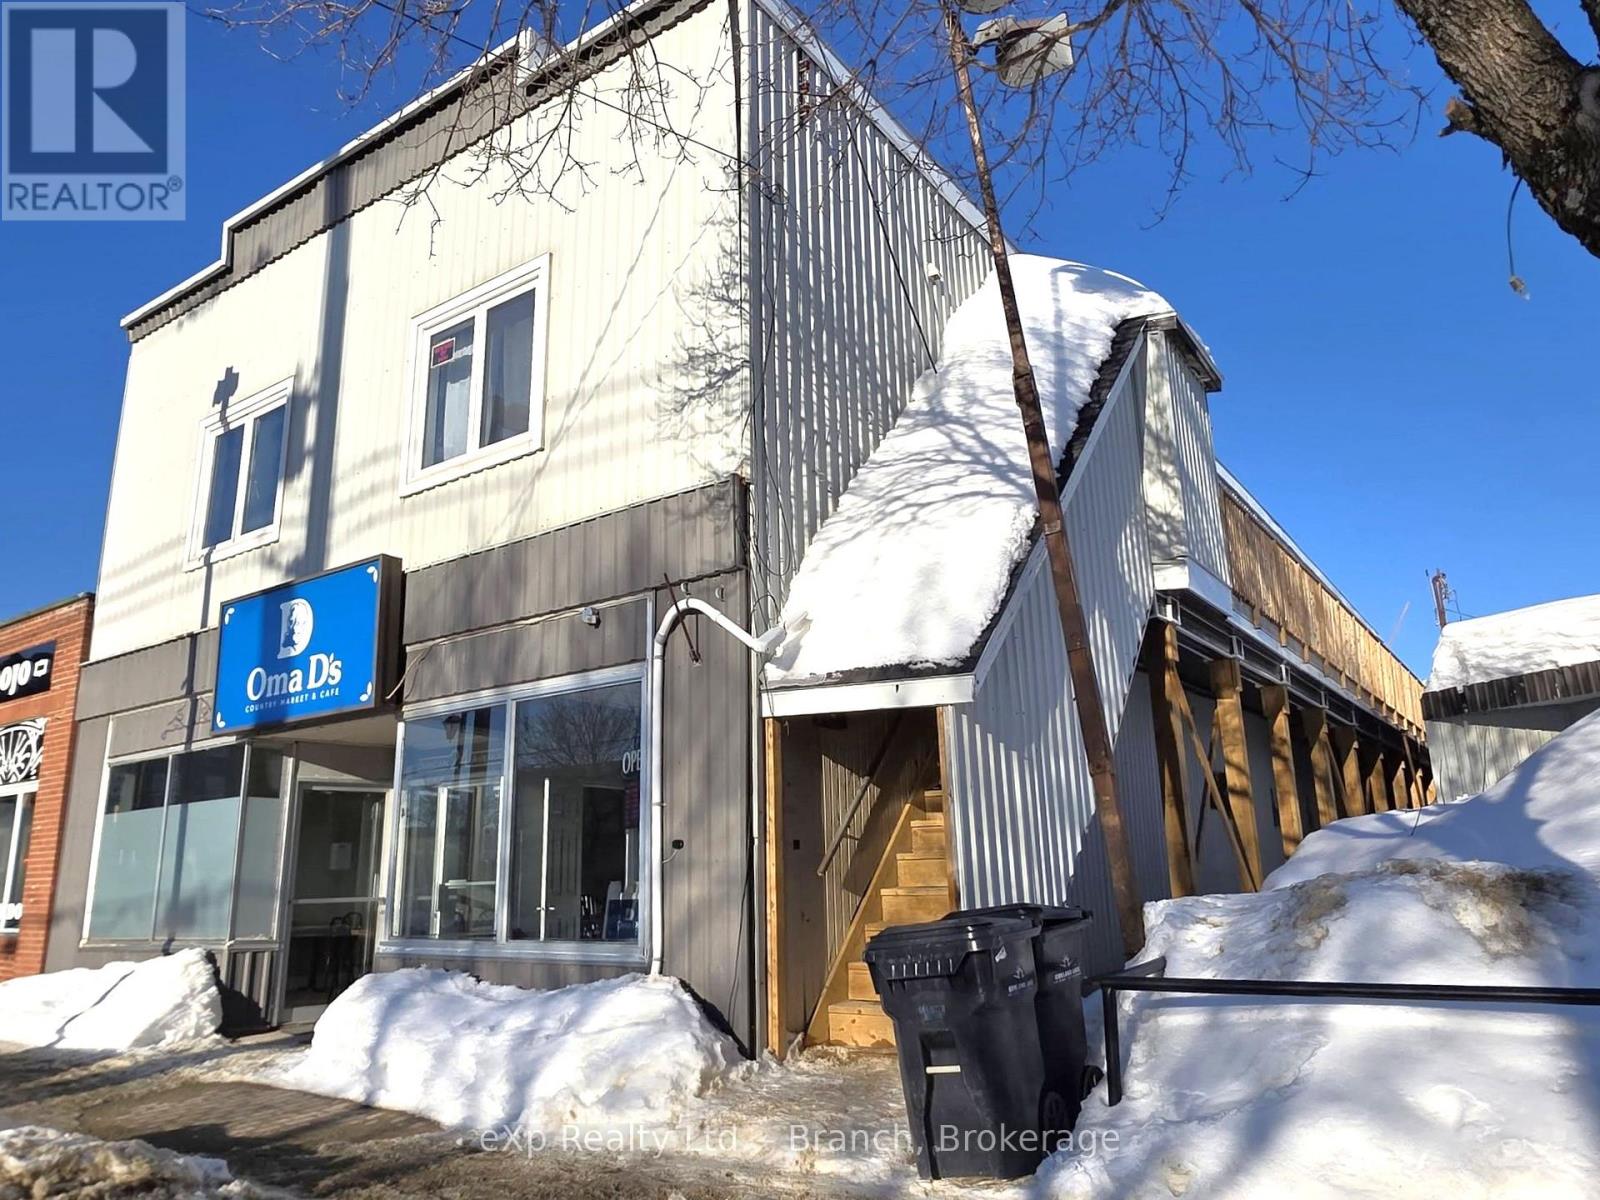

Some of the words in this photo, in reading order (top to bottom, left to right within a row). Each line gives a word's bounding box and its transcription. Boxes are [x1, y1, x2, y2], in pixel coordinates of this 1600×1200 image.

[246, 667, 303, 701] Oma
[307, 652, 342, 690] D's
[280, 693, 309, 706] MARKET
[320, 688, 340, 699] CAFE
